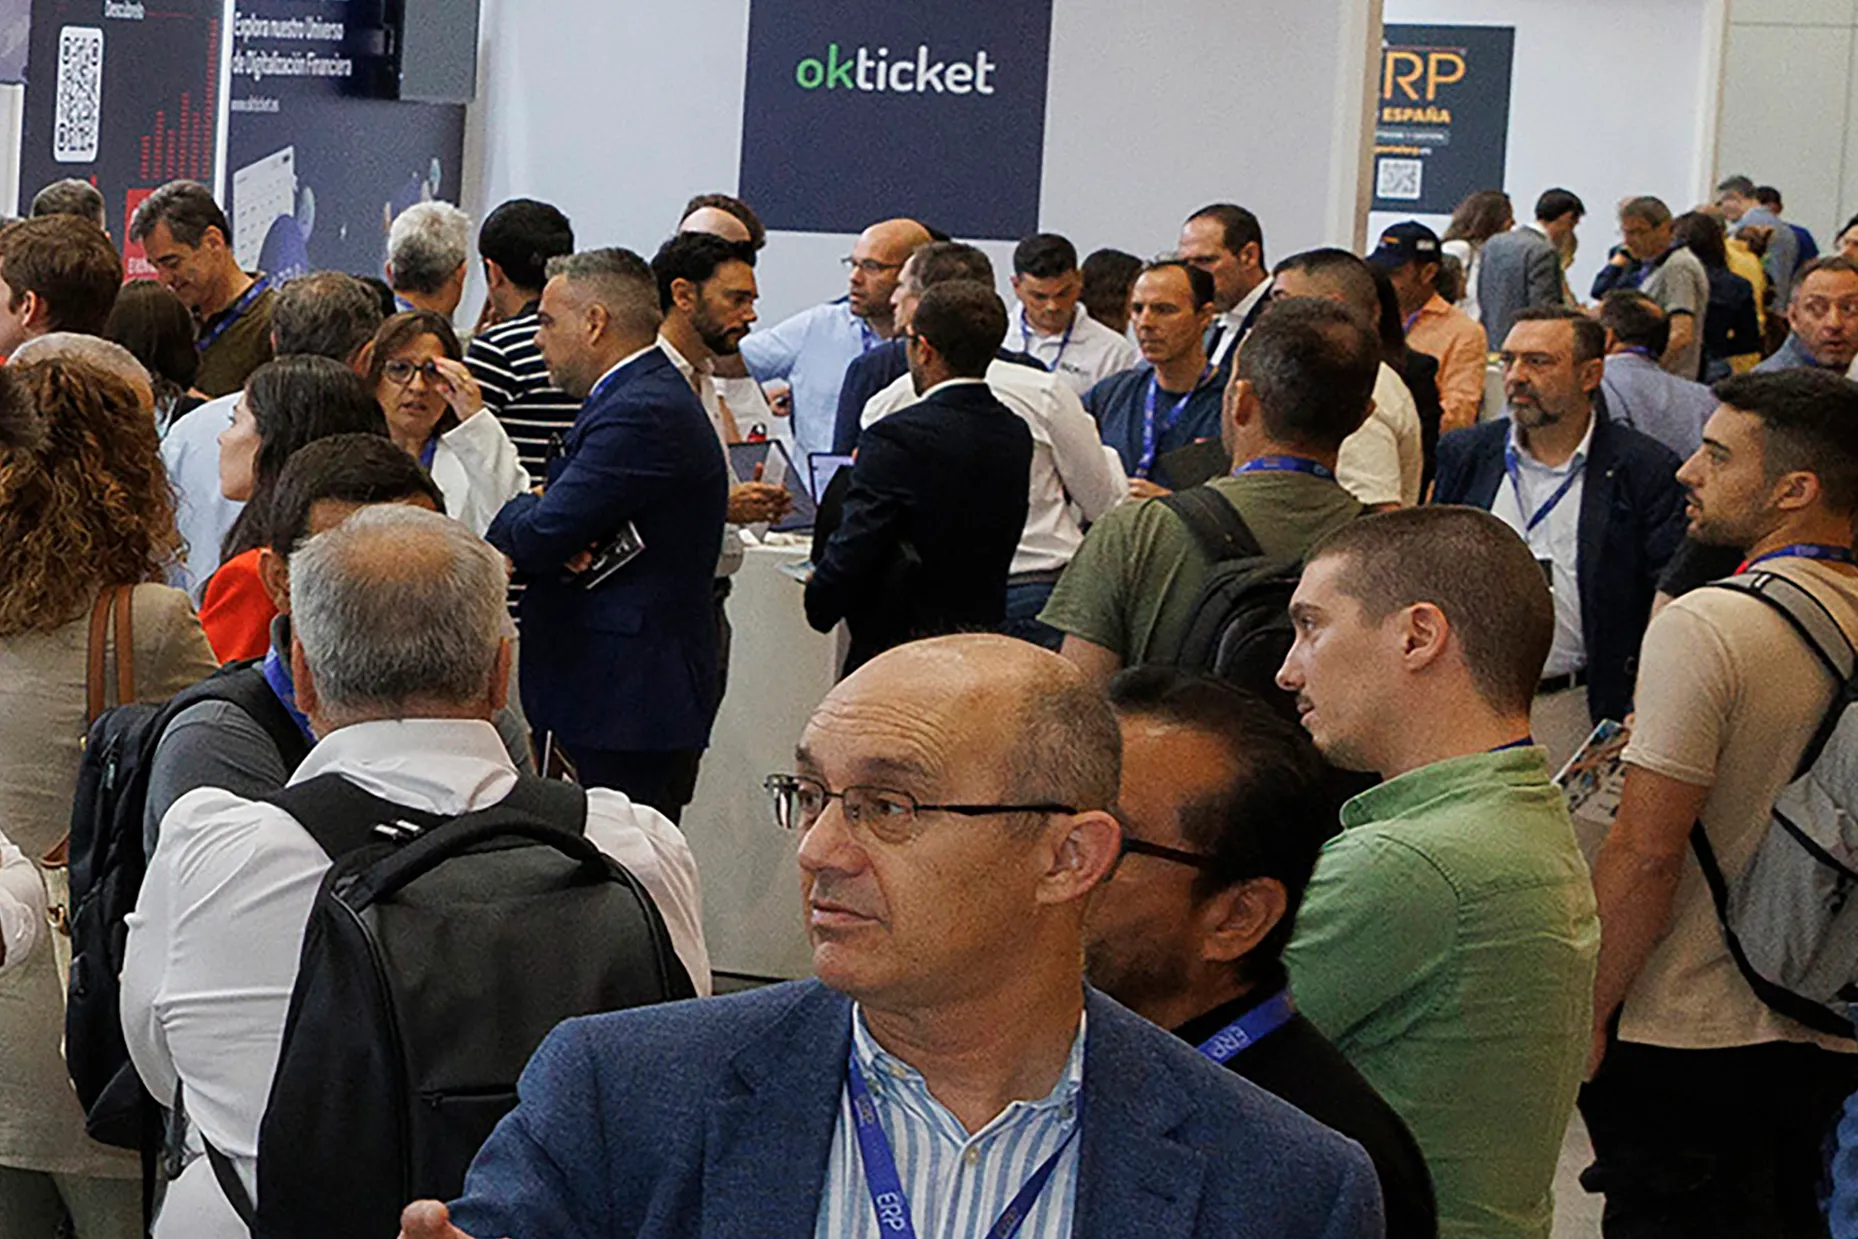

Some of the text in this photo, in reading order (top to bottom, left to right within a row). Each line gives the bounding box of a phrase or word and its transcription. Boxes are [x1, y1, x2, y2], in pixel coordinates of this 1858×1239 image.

[796, 44, 996, 94] okticket
[1383, 105, 1452, 124] ESPAÑA
[1210, 1025, 1249, 1059] ERP
[877, 1191, 906, 1232] ERP
